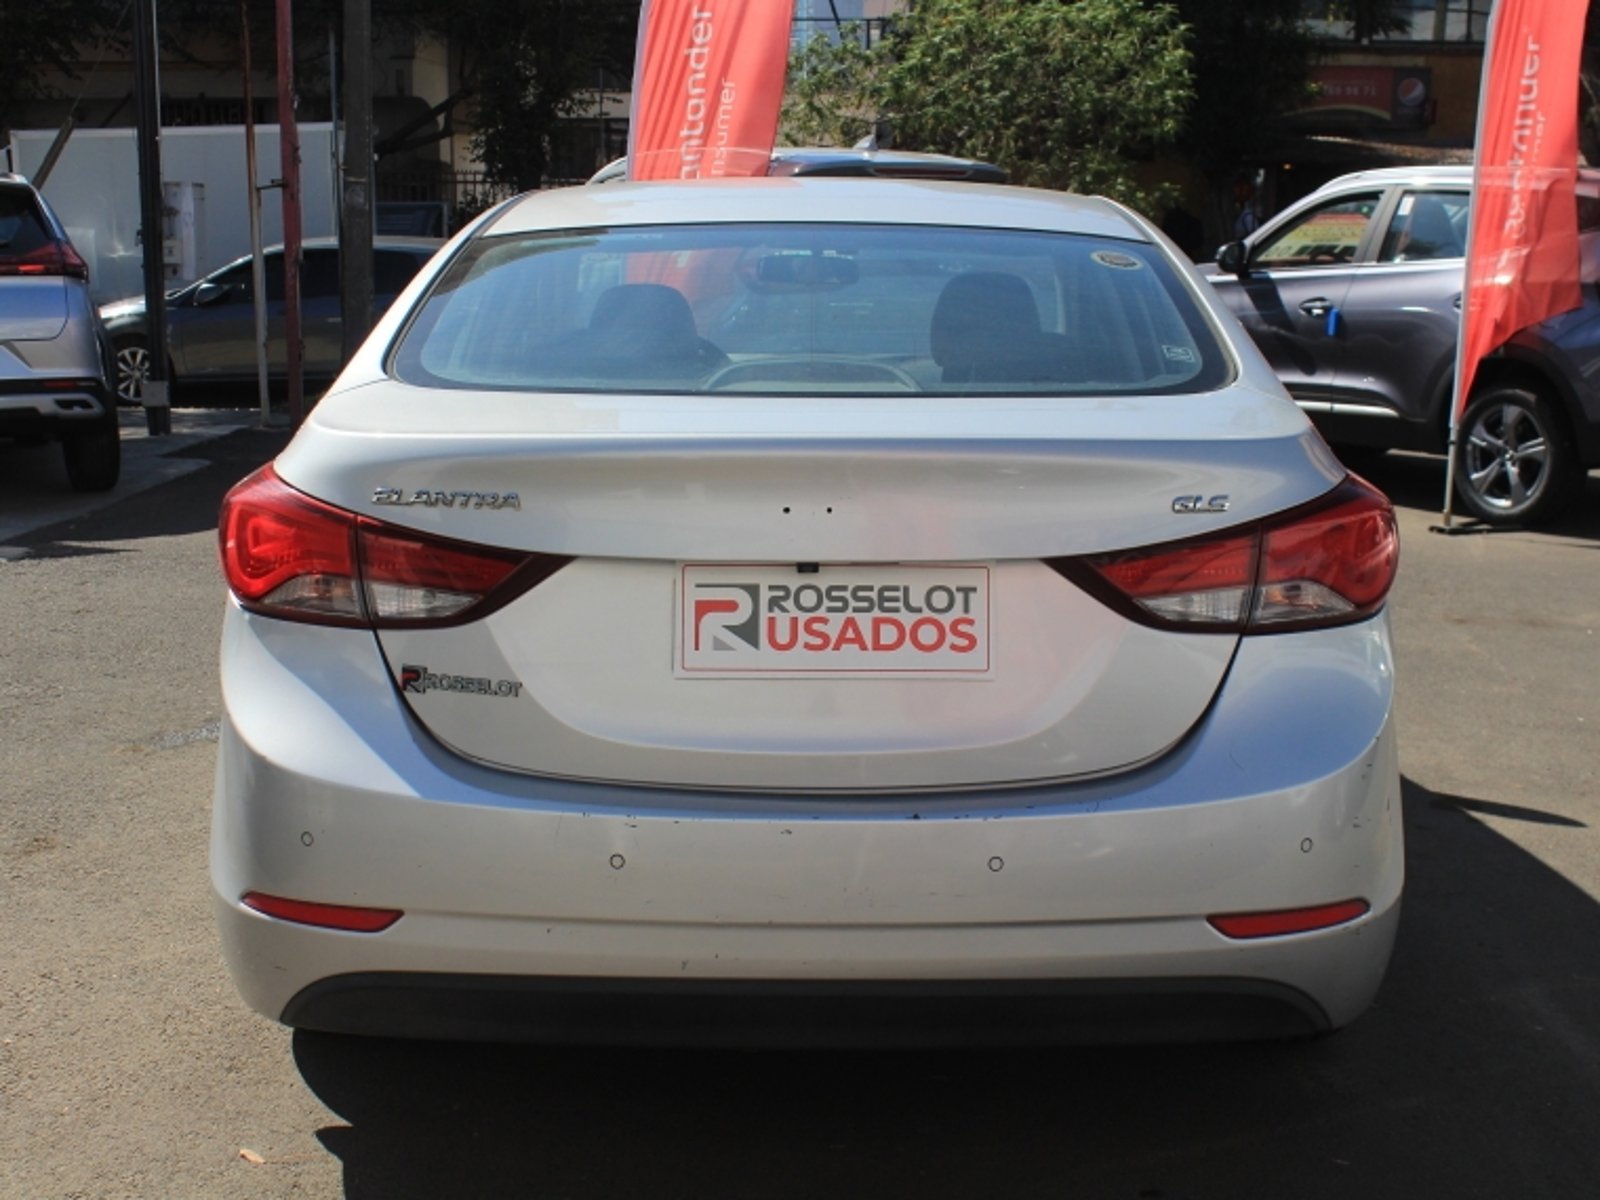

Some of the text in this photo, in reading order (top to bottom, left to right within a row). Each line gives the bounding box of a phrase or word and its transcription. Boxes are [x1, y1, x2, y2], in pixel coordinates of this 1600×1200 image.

[680, 5, 713, 180] antander
[711, 78, 736, 176] nsumer
[372, 487, 522, 512] ELANTRA
[1171, 494, 1230, 514] GLS
[767, 584, 978, 614] ROSSELOT
[766, 615, 978, 653] USADOS
[425, 673, 524, 698] ROSSELOT
